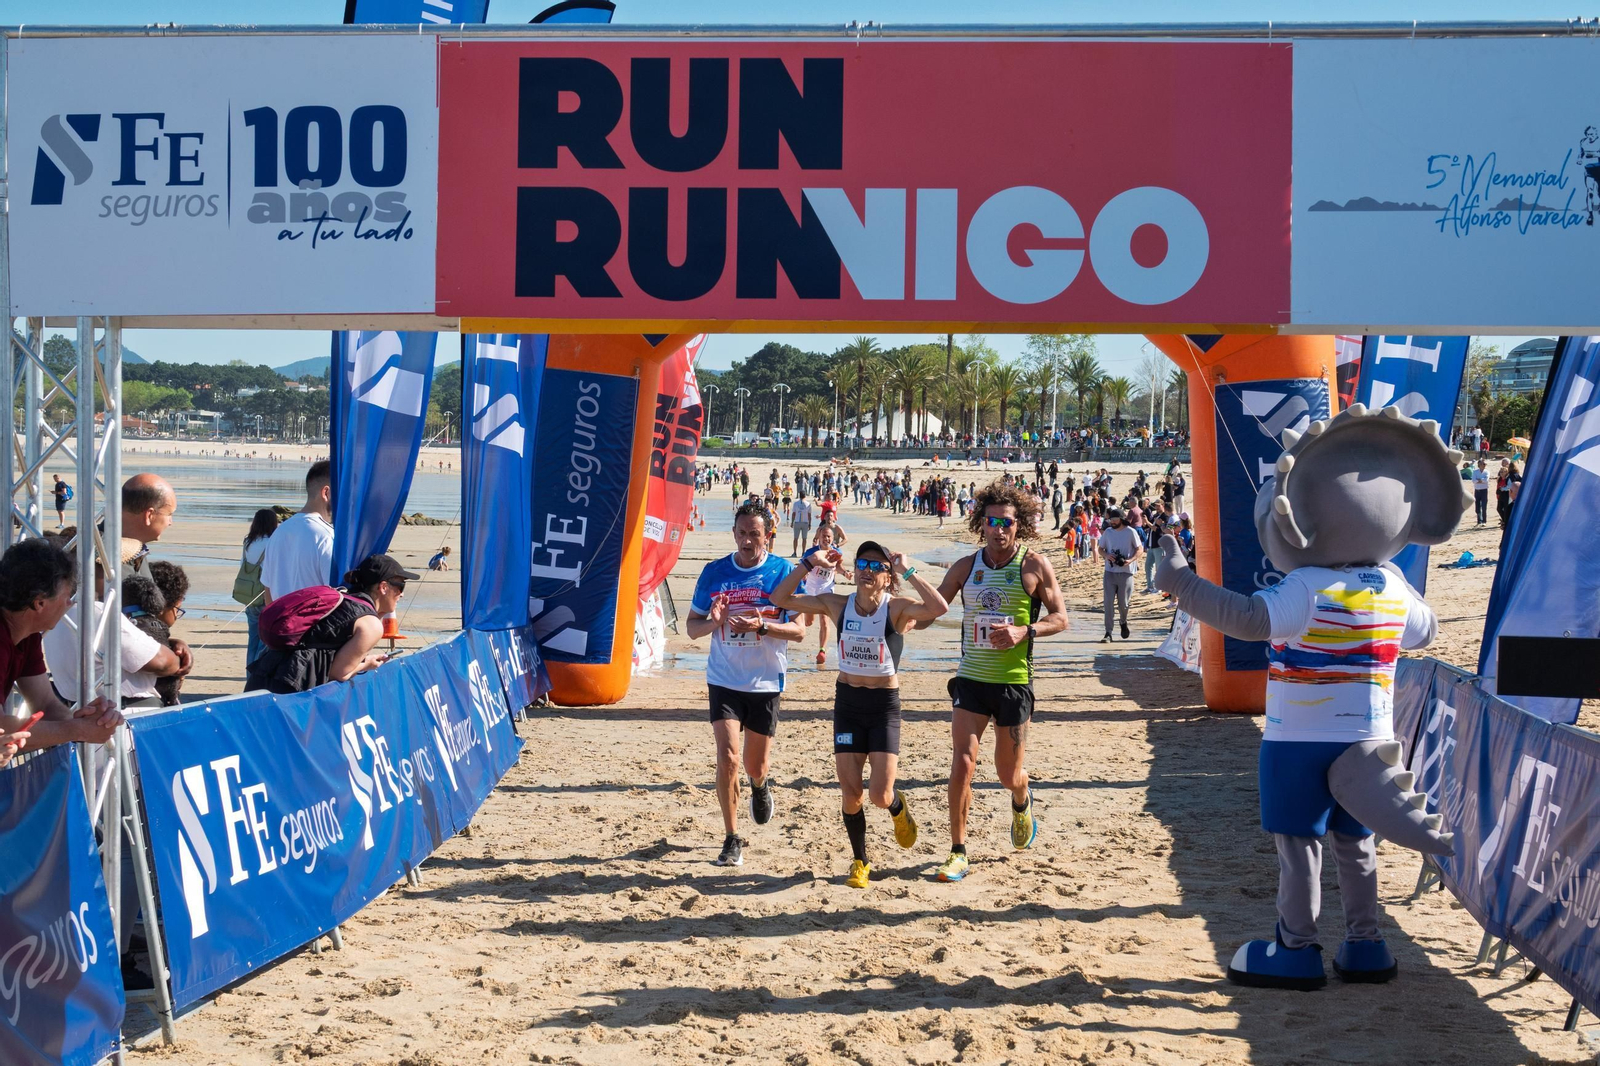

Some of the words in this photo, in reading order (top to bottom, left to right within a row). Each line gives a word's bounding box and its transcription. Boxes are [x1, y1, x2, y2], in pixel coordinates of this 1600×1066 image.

[517, 57, 845, 172] RUN
[243, 104, 408, 188] 100
[1461, 148, 1573, 201] Memorial
[98, 190, 220, 227] seguros
[246, 178, 408, 224] años
[352, 210, 414, 244] lado
[1516, 185, 1585, 236] Varela
[567, 380, 602, 507] seguros
[649, 393, 679, 479] RUN
[845, 651, 879, 661] VAQUERO
[851, 645, 871, 654] JULIA
[279, 796, 344, 874] seguros
